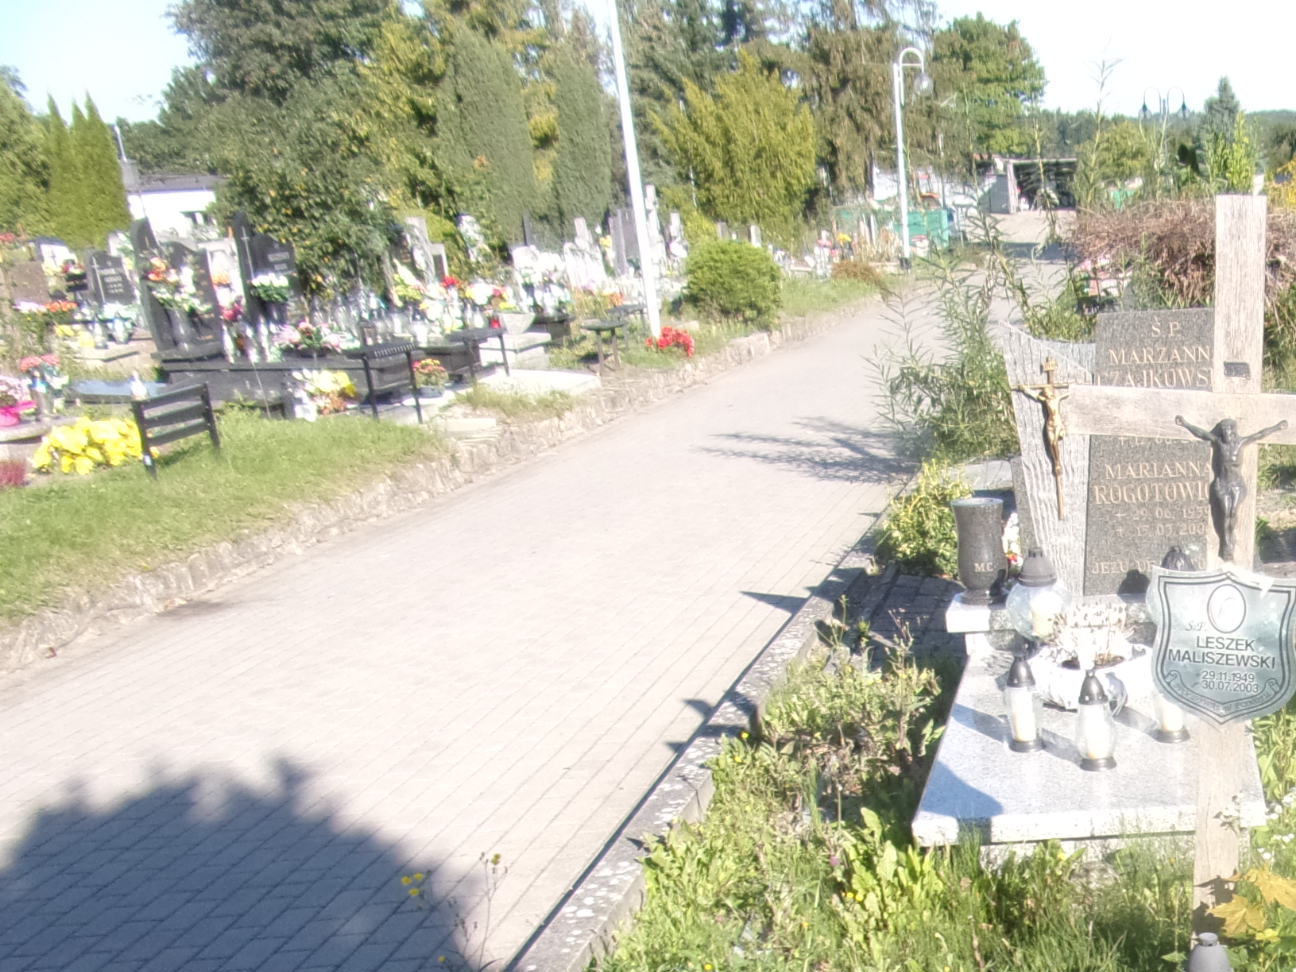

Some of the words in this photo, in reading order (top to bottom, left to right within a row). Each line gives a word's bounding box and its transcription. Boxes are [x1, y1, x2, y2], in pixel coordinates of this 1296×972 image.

[1108, 345, 1211, 365] MARZANN
[1196, 635, 1255, 652] LESZEK
[1168, 648, 1276, 670] MALISZEWSKI
[1202, 670, 1255, 683] 29.11.1949
[1202, 680, 1260, 694] 30.07.2003
